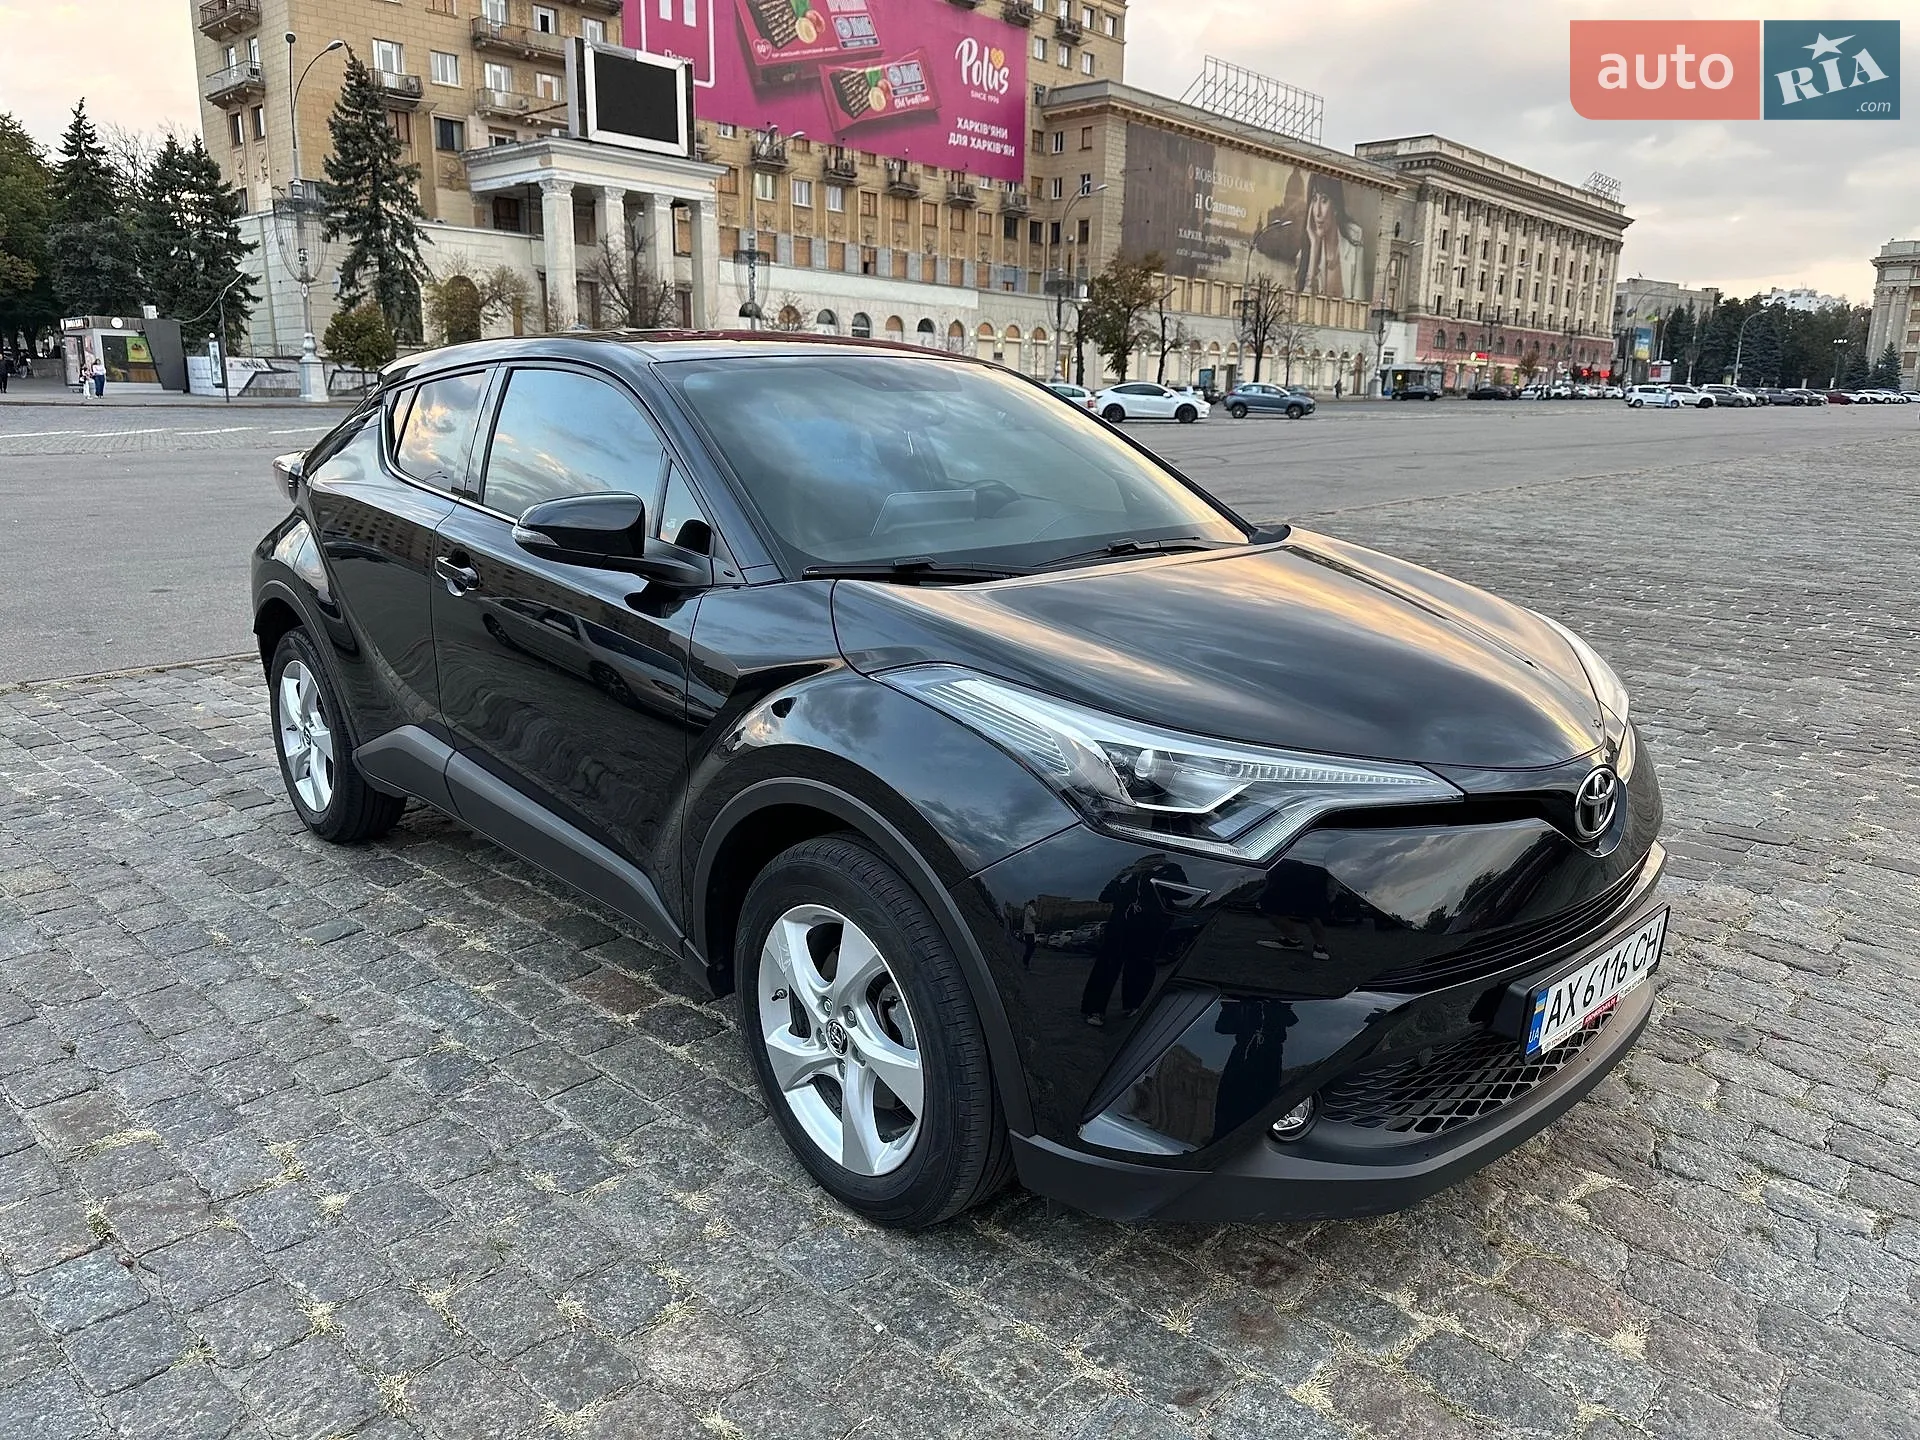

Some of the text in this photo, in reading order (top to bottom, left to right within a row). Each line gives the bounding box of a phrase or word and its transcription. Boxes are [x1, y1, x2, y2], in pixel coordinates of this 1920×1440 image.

[955, 38, 1009, 94] Polus
[971, 91, 986, 102] SINCE
[957, 118, 1008, 139] ХАРКІВ'ЯНИ
[948, 132, 1015, 156] ДЛЯ ХАРКІВ'ЯН
[1205, 196, 1246, 217] Cammeo
[1544, 975, 1583, 1035] AX
[1583, 941, 1633, 1008] 6116
[1632, 921, 1662, 972] CH
[1529, 1027, 1541, 1044] UA
